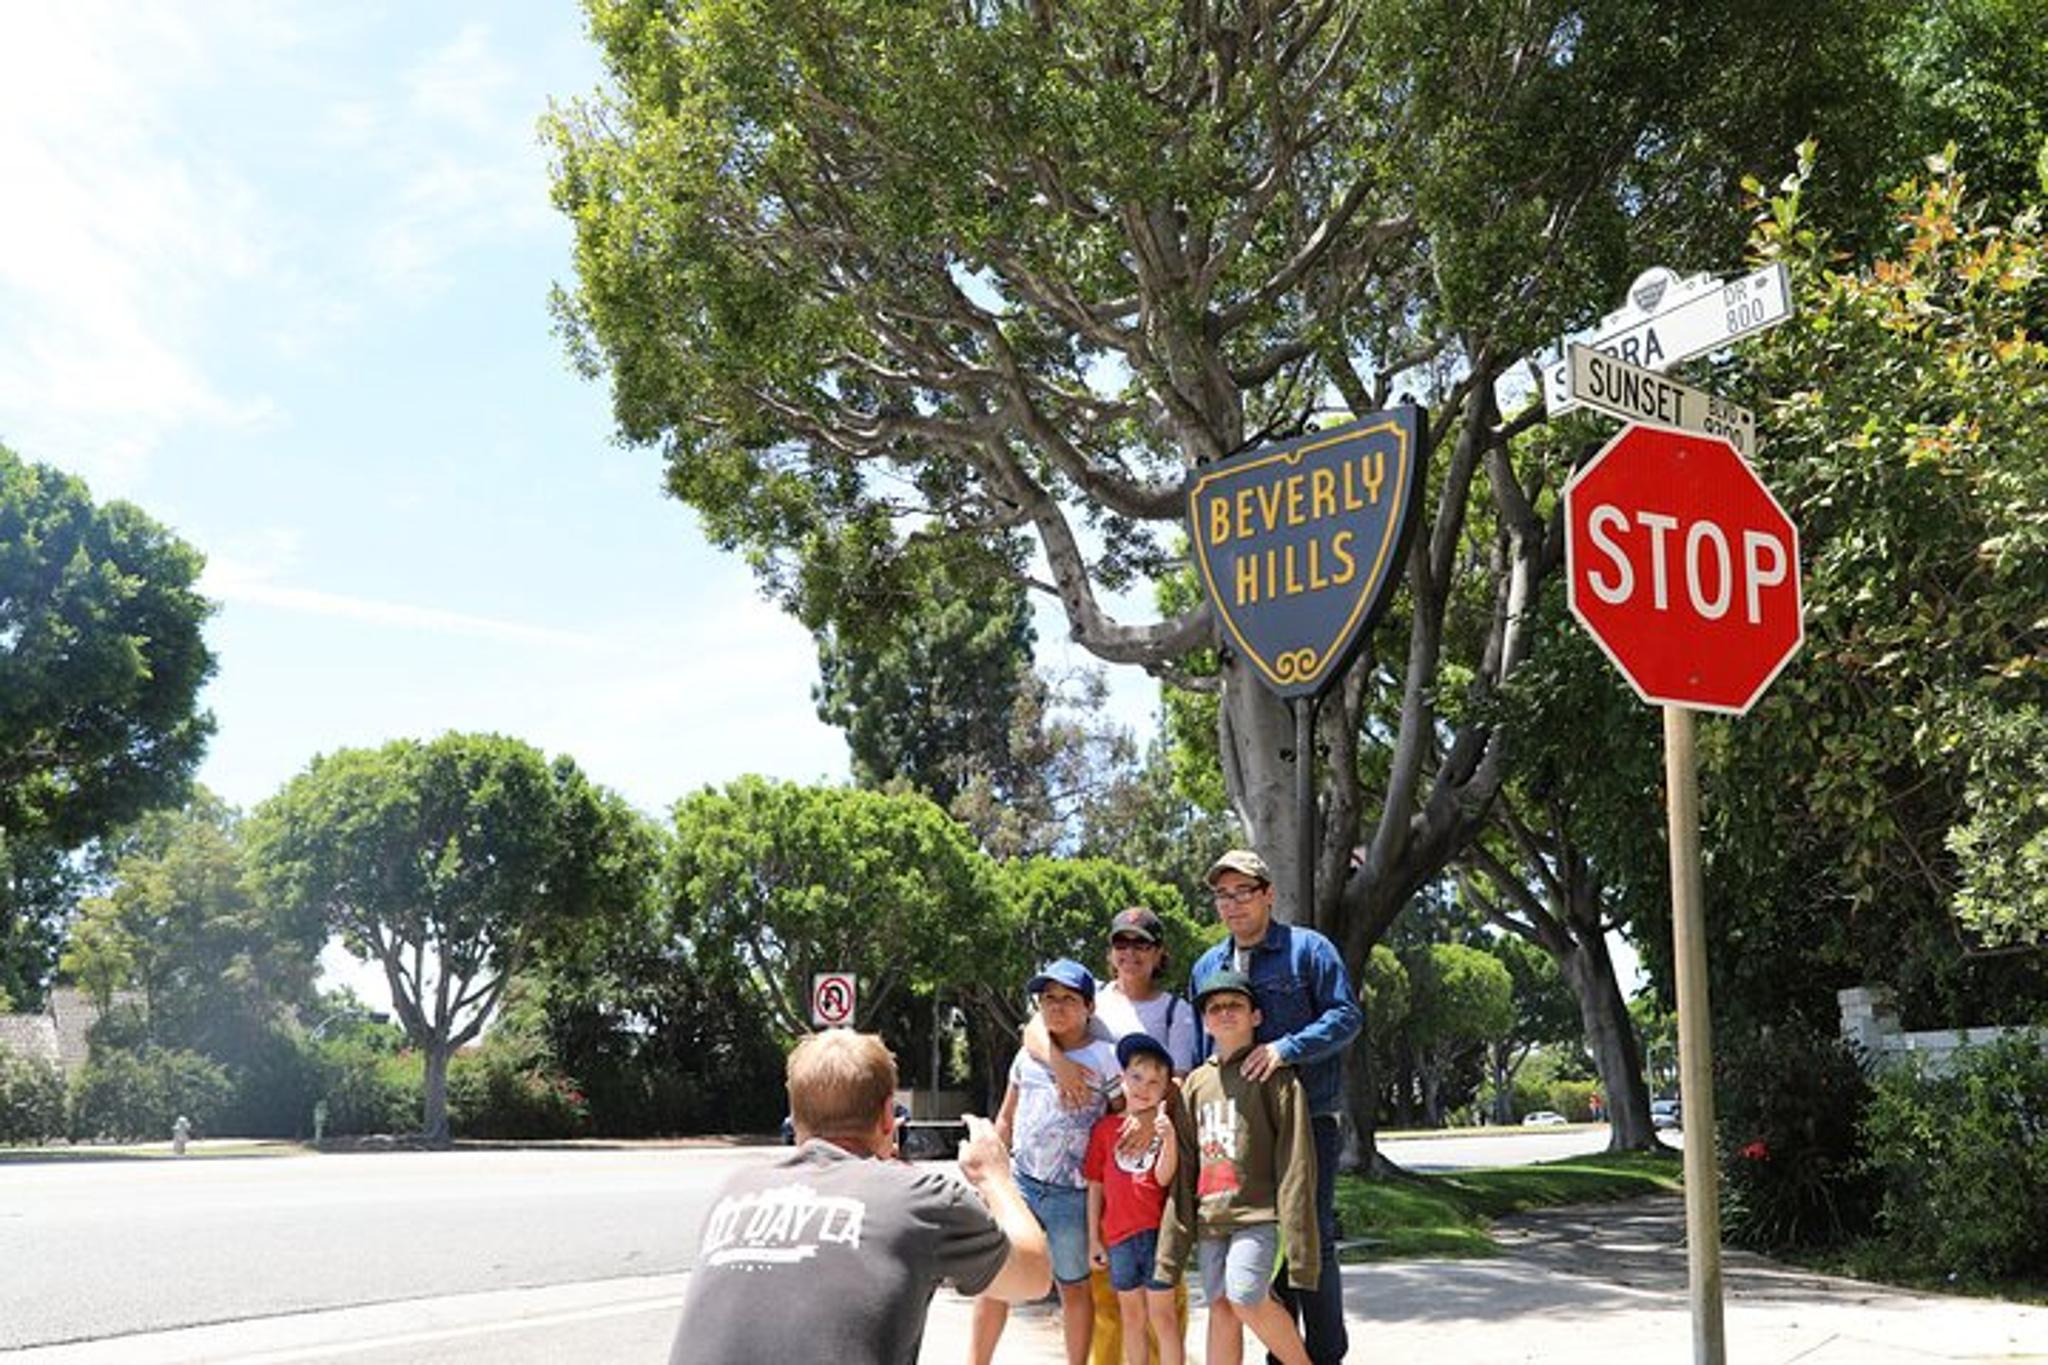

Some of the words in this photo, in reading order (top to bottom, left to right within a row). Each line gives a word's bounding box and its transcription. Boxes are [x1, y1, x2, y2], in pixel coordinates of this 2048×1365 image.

[1723, 281, 1748, 307] DR
[1726, 298, 1764, 333] 800
[1588, 357, 1685, 427] SUNSET
[1210, 451, 1385, 545] BEVERLY
[1236, 531, 1356, 607] HILLS
[1586, 504, 1788, 625] STOP
[743, 1197, 818, 1243] DAY
[818, 1198, 866, 1249] LA
